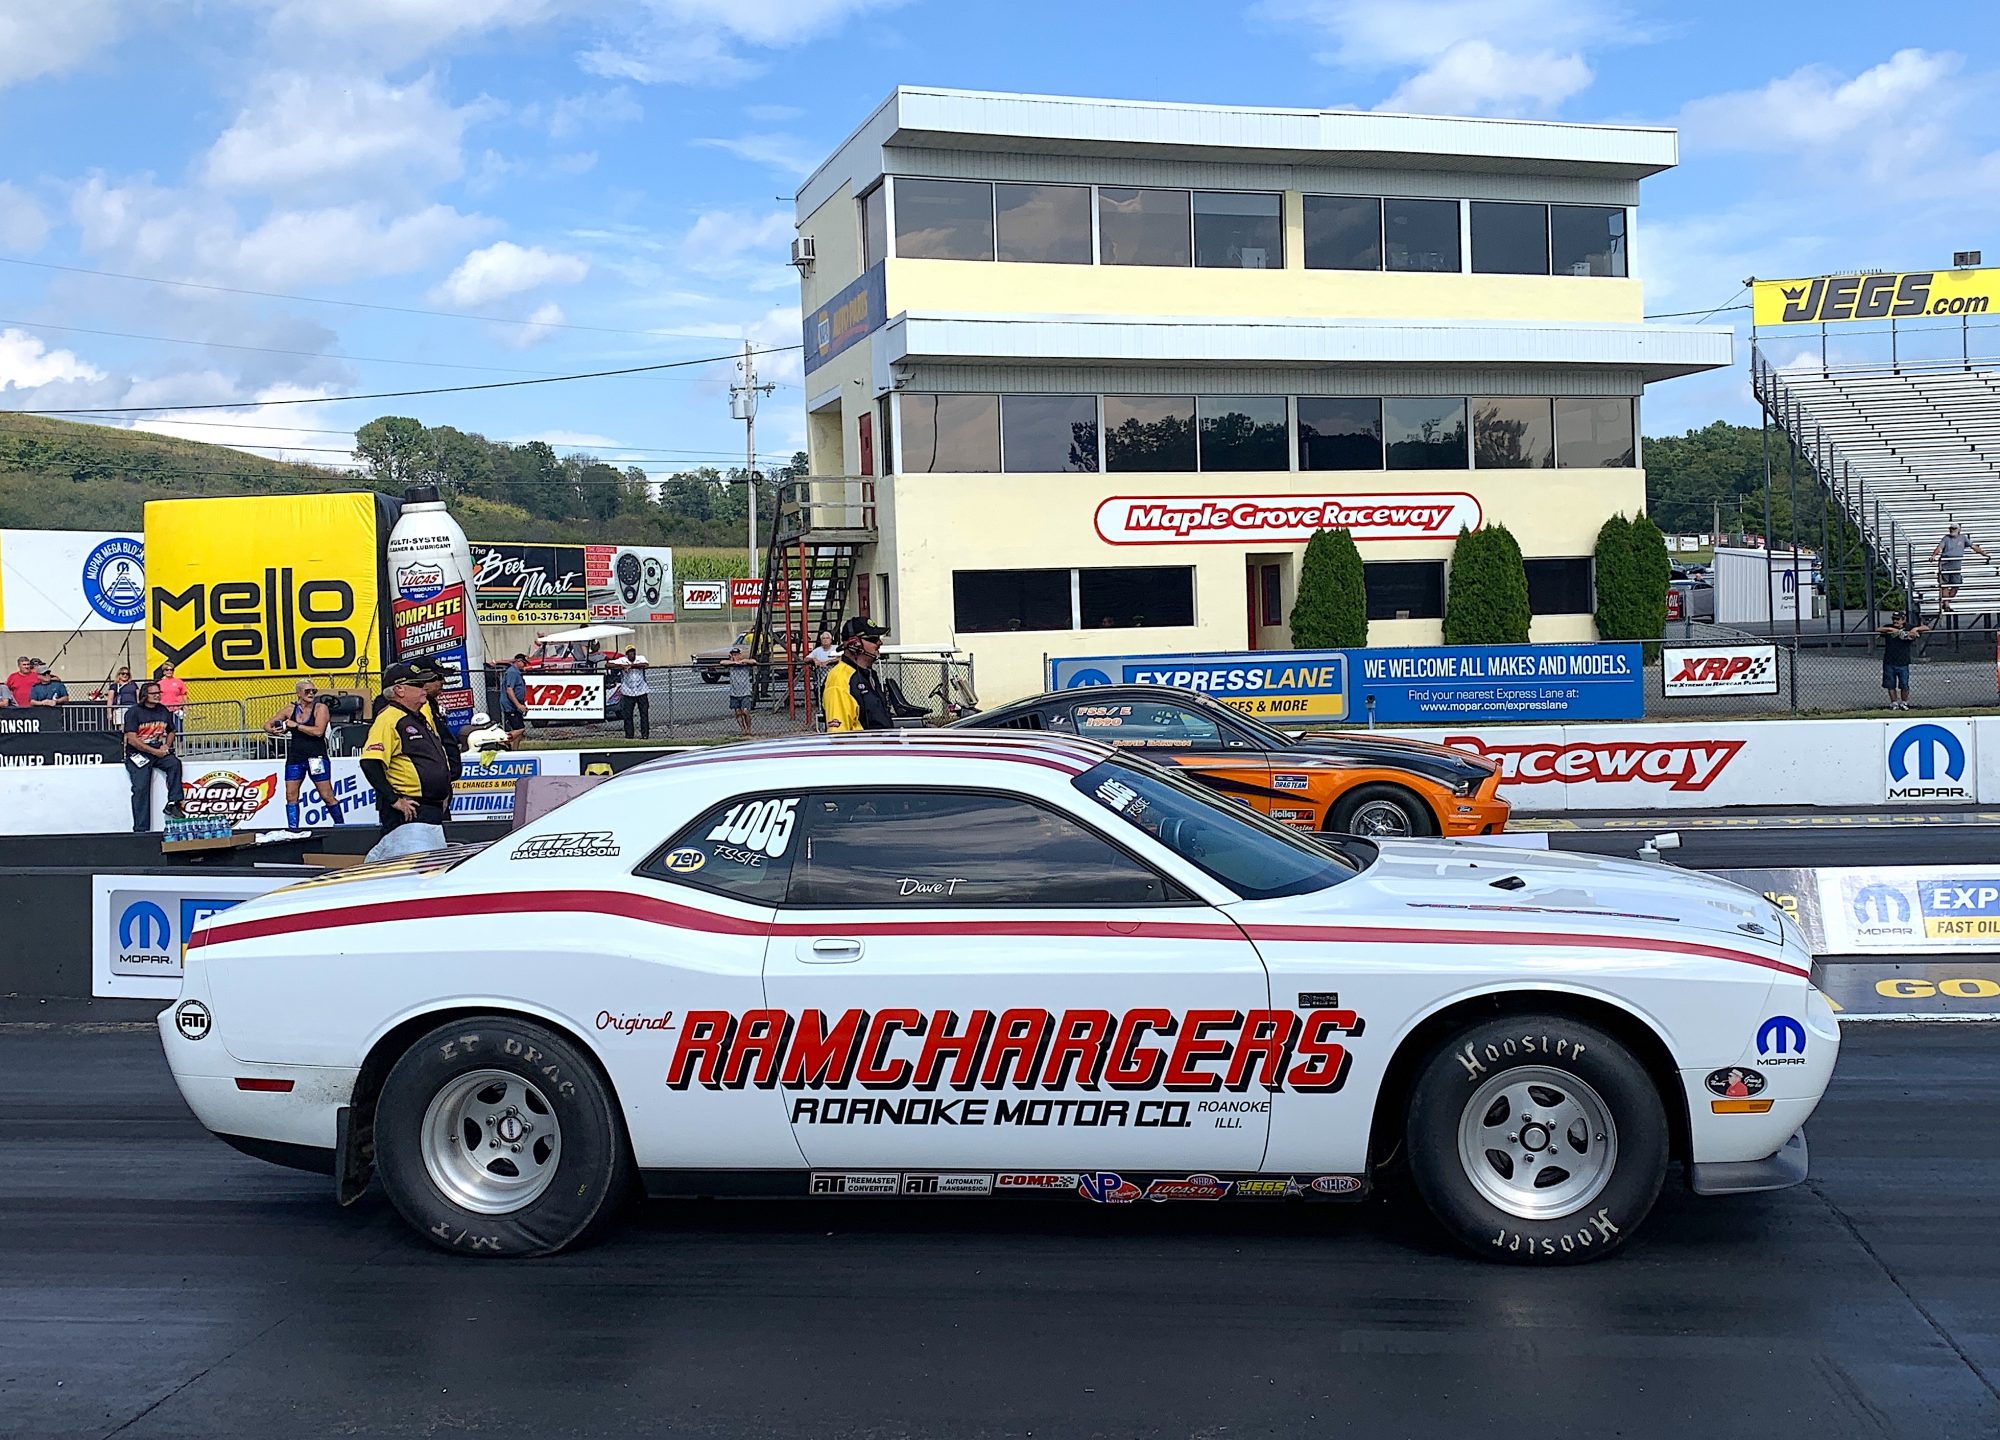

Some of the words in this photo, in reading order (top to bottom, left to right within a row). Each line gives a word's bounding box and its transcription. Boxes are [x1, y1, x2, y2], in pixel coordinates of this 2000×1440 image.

[1783, 274, 1989, 322] JEGS.com
[1127, 503, 1228, 535] Maple
[1231, 505, 1320, 529] Grove
[1322, 501, 1456, 530] Raceway
[416, 543, 451, 551] LUBRICANT
[470, 546, 486, 555] The
[87, 553, 105, 580] MOPAR
[101, 543, 122, 556] MEGA
[474, 549, 543, 590] Beer
[402, 574, 439, 586] LUCAS
[410, 585, 442, 593] PRODUCTS
[513, 571, 583, 611] Mart
[686, 590, 712, 601] XRP
[395, 597, 461, 628] COMPLETE
[517, 611, 587, 622] 610-376-7341
[590, 606, 624, 616] JESEL
[406, 619, 444, 637] ENGINE
[401, 626, 455, 648] TREATMENT
[436, 640, 458, 651] DIESEL
[1364, 659, 1386, 678] WE
[1389, 658, 1457, 678] WELCOME
[1459, 657, 1485, 677] ALL
[1488, 657, 1535, 676] MAKES
[1538, 656, 1567, 675] AND
[1570, 655, 1631, 675] MODELS.
[1670, 657, 1753, 682] XRP
[1134, 666, 1335, 691] EXPRESSLANE
[524, 684, 584, 706] XRP
[1408, 690, 1430, 701] Find
[1431, 690, 1454, 702] your
[1457, 689, 1494, 700] nearest
[1496, 689, 1537, 702] Express
[1539, 689, 1564, 699] Lane
[1566, 688, 1580, 699] at:
[1256, 702, 1266, 712] &
[1269, 700, 1308, 712] MORE
[1420, 700, 1568, 712] www.mopar.com/expresslane
[0, 719, 40, 733] ONSOR
[461, 763, 534, 777] RESSLANE
[1443, 736, 1747, 792] aceway
[186, 785, 258, 801] Maple
[1890, 788, 1964, 798] MOPAR
[185, 801, 258, 812] Grove
[1271, 811, 1297, 820] Holley
[705, 798, 800, 858] 1005
[511, 846, 620, 860] RACECARS.COM
[1933, 888, 2000, 909] EXP
[1857, 927, 1913, 936] MOPAR
[1937, 920, 1974, 933] FAST
[119, 954, 171, 965] MOPAR
[182, 1012, 206, 1028] ATI
[596, 1010, 676, 1036] Original
[666, 1008, 1366, 1094] RAMCHARGERS
[1455, 1034, 1586, 1081] Hoosier
[1756, 1058, 1806, 1066] MOPAR
[791, 1098, 990, 1126] ROANOKE
[993, 1100, 1128, 1127] MOTOR
[1134, 1101, 1191, 1129] CO.
[1198, 1101, 1271, 1114] ROANOKE
[814, 1176, 846, 1192] ATI
[906, 1177, 938, 1192] ATI
[1000, 1175, 1059, 1185] COMP
[1191, 1177, 1216, 1185] NHRA
[1240, 1182, 1286, 1191] JEGS
[1320, 1179, 1353, 1190] NHRA
[1080, 1172, 1122, 1203] VP
[1154, 1185, 1197, 1194] LUCAS
[1492, 1207, 1619, 1255] Hoosier
